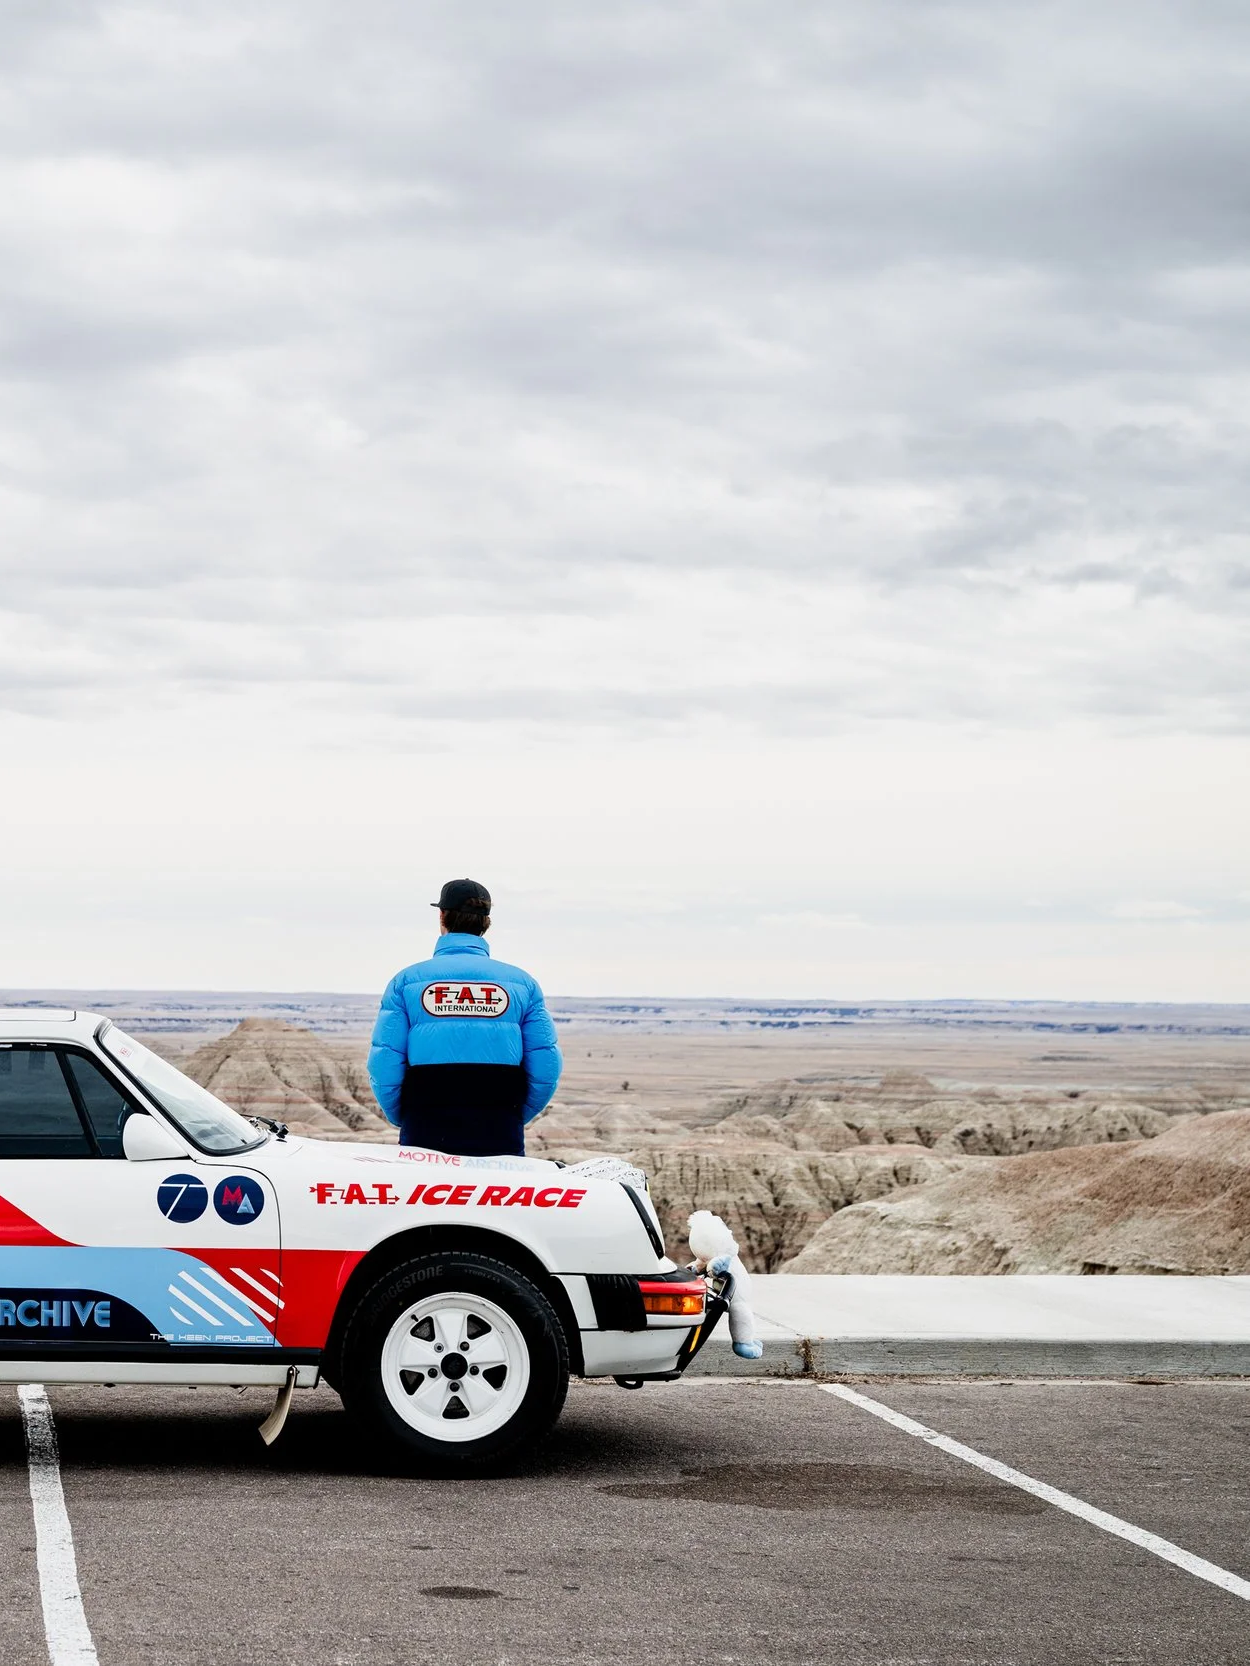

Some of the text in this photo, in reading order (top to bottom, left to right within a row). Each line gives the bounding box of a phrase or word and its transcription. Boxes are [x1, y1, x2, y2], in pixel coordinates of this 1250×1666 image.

[435, 1005, 498, 1013] INTERNATIONAL
[398, 1150, 461, 1167] MOTIVE
[406, 1184, 477, 1207] ICE
[476, 1185, 588, 1208] RACE
[149, 1333, 175, 1341] THE
[215, 1335, 273, 1343] PROJECT
